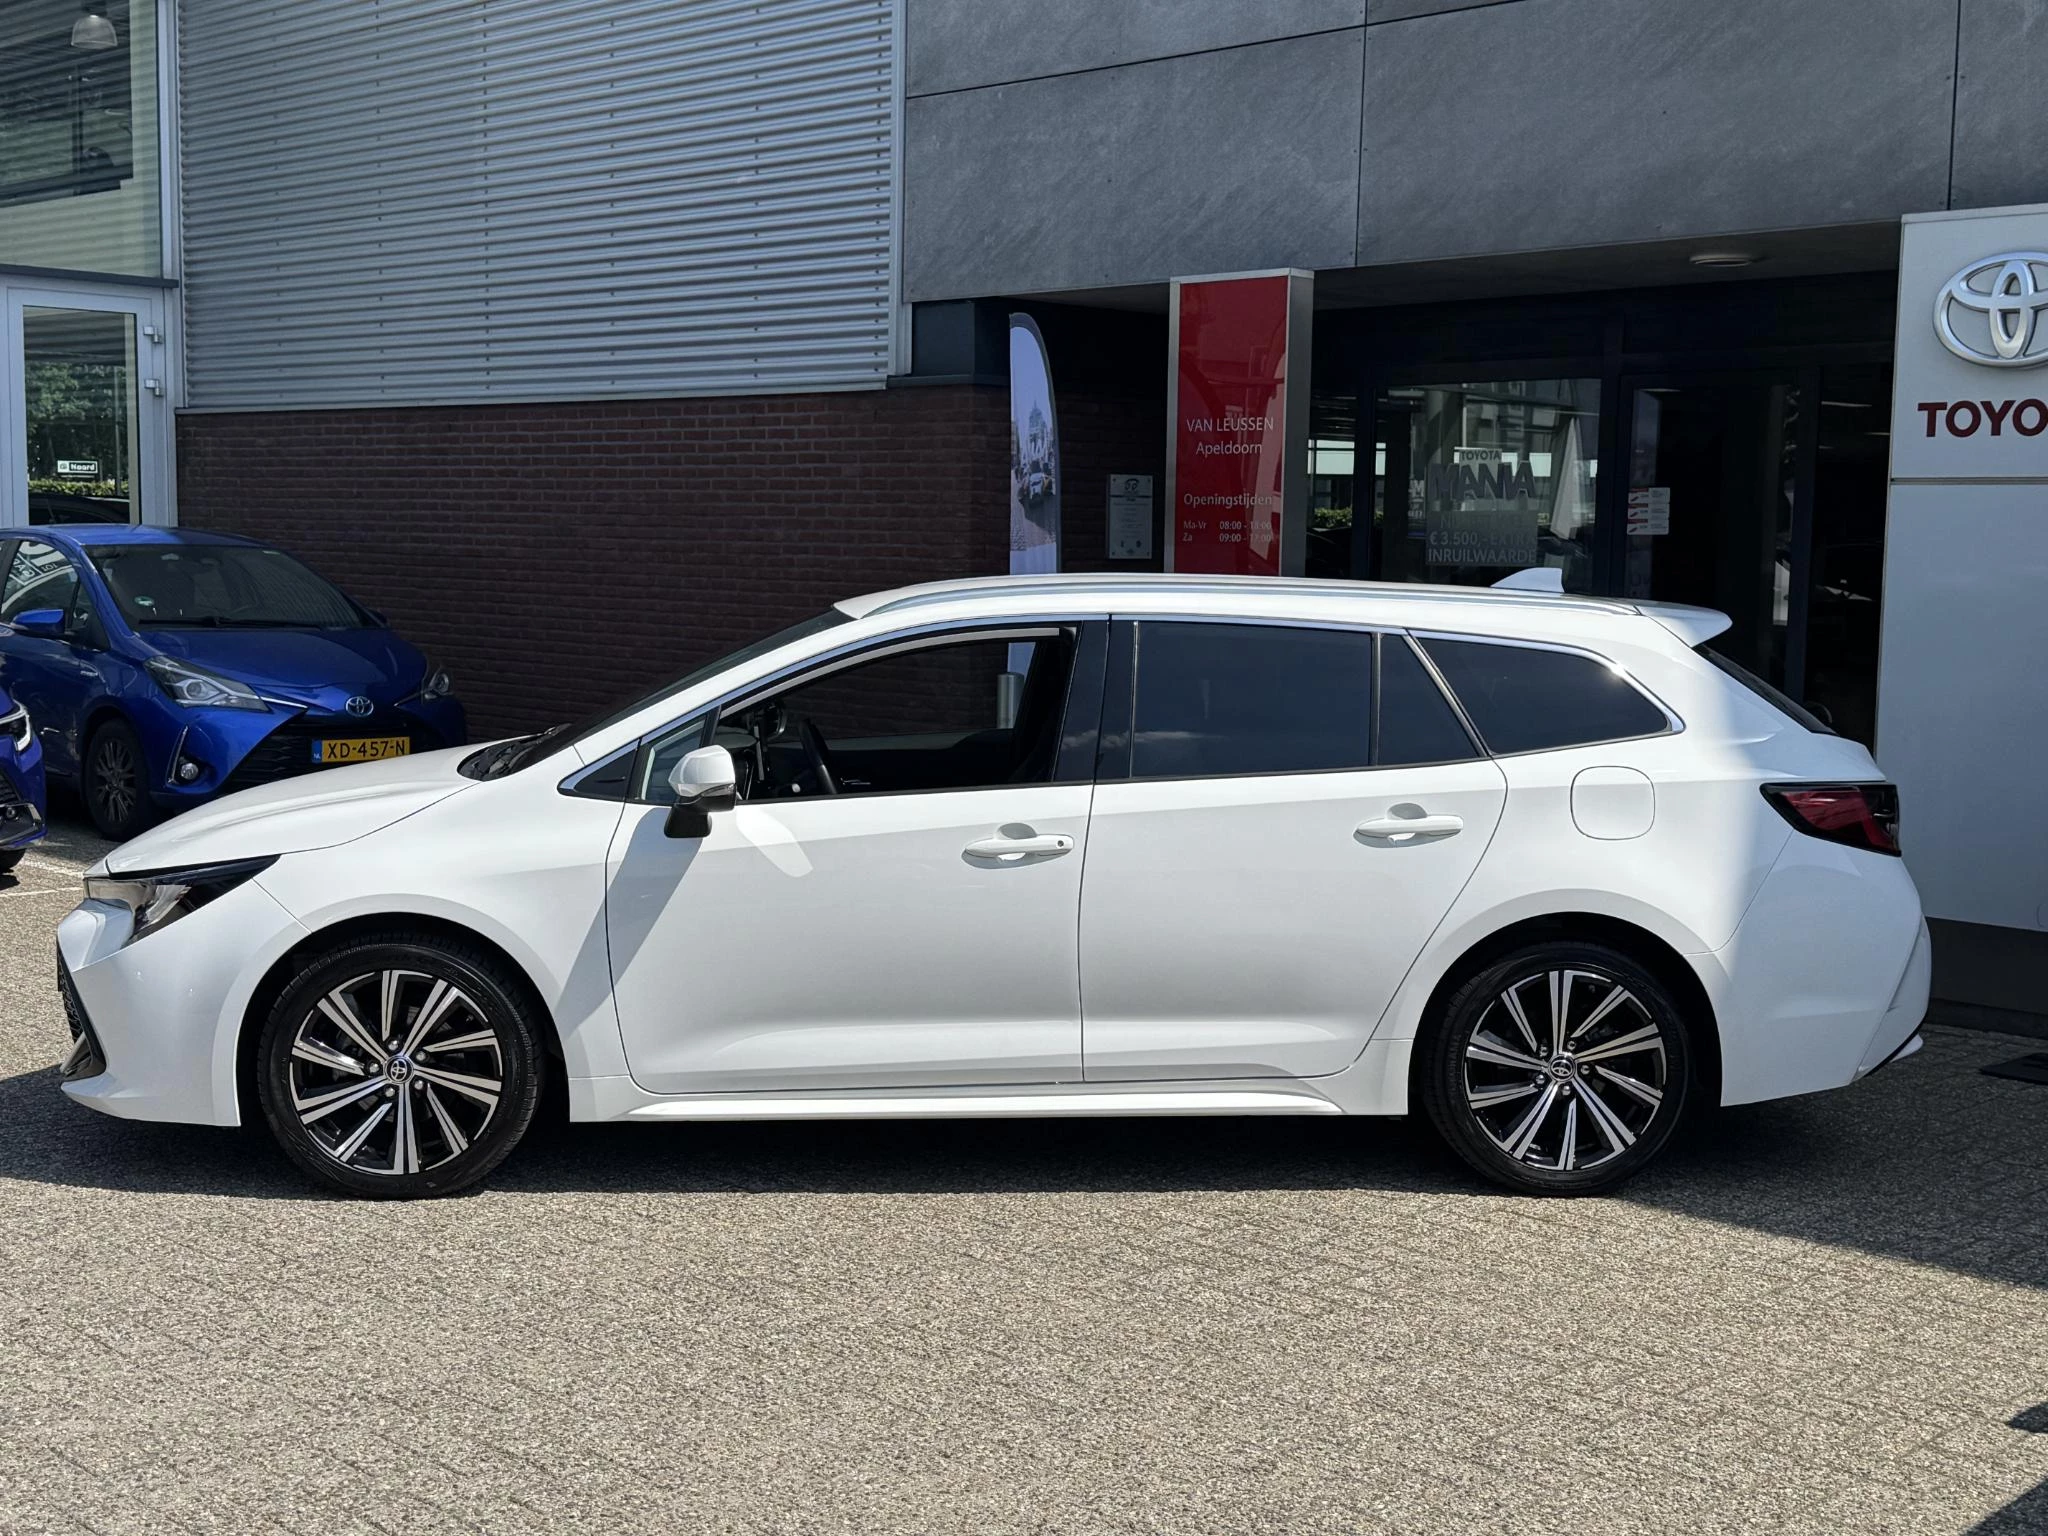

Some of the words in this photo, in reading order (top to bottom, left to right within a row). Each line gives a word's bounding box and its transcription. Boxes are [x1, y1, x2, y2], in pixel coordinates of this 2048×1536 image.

[1186, 418, 1212, 432] VAN
[1216, 417, 1274, 432] LEUSSEN
[1196, 441, 1263, 458] Apeldoorn
[1460, 450, 1502, 460] TOYOTA
[1430, 461, 1538, 500] MANIA
[1183, 493, 1273, 509] Openingstijden
[1183, 520, 1207, 529] Ma-Vr
[1219, 520, 1242, 530] 08:00
[1183, 532, 1193, 542] Za
[1219, 532, 1242, 542] 09:00
[1428, 547, 1537, 563] INRUILWAARDE
[327, 740, 405, 759] XD-457-N
